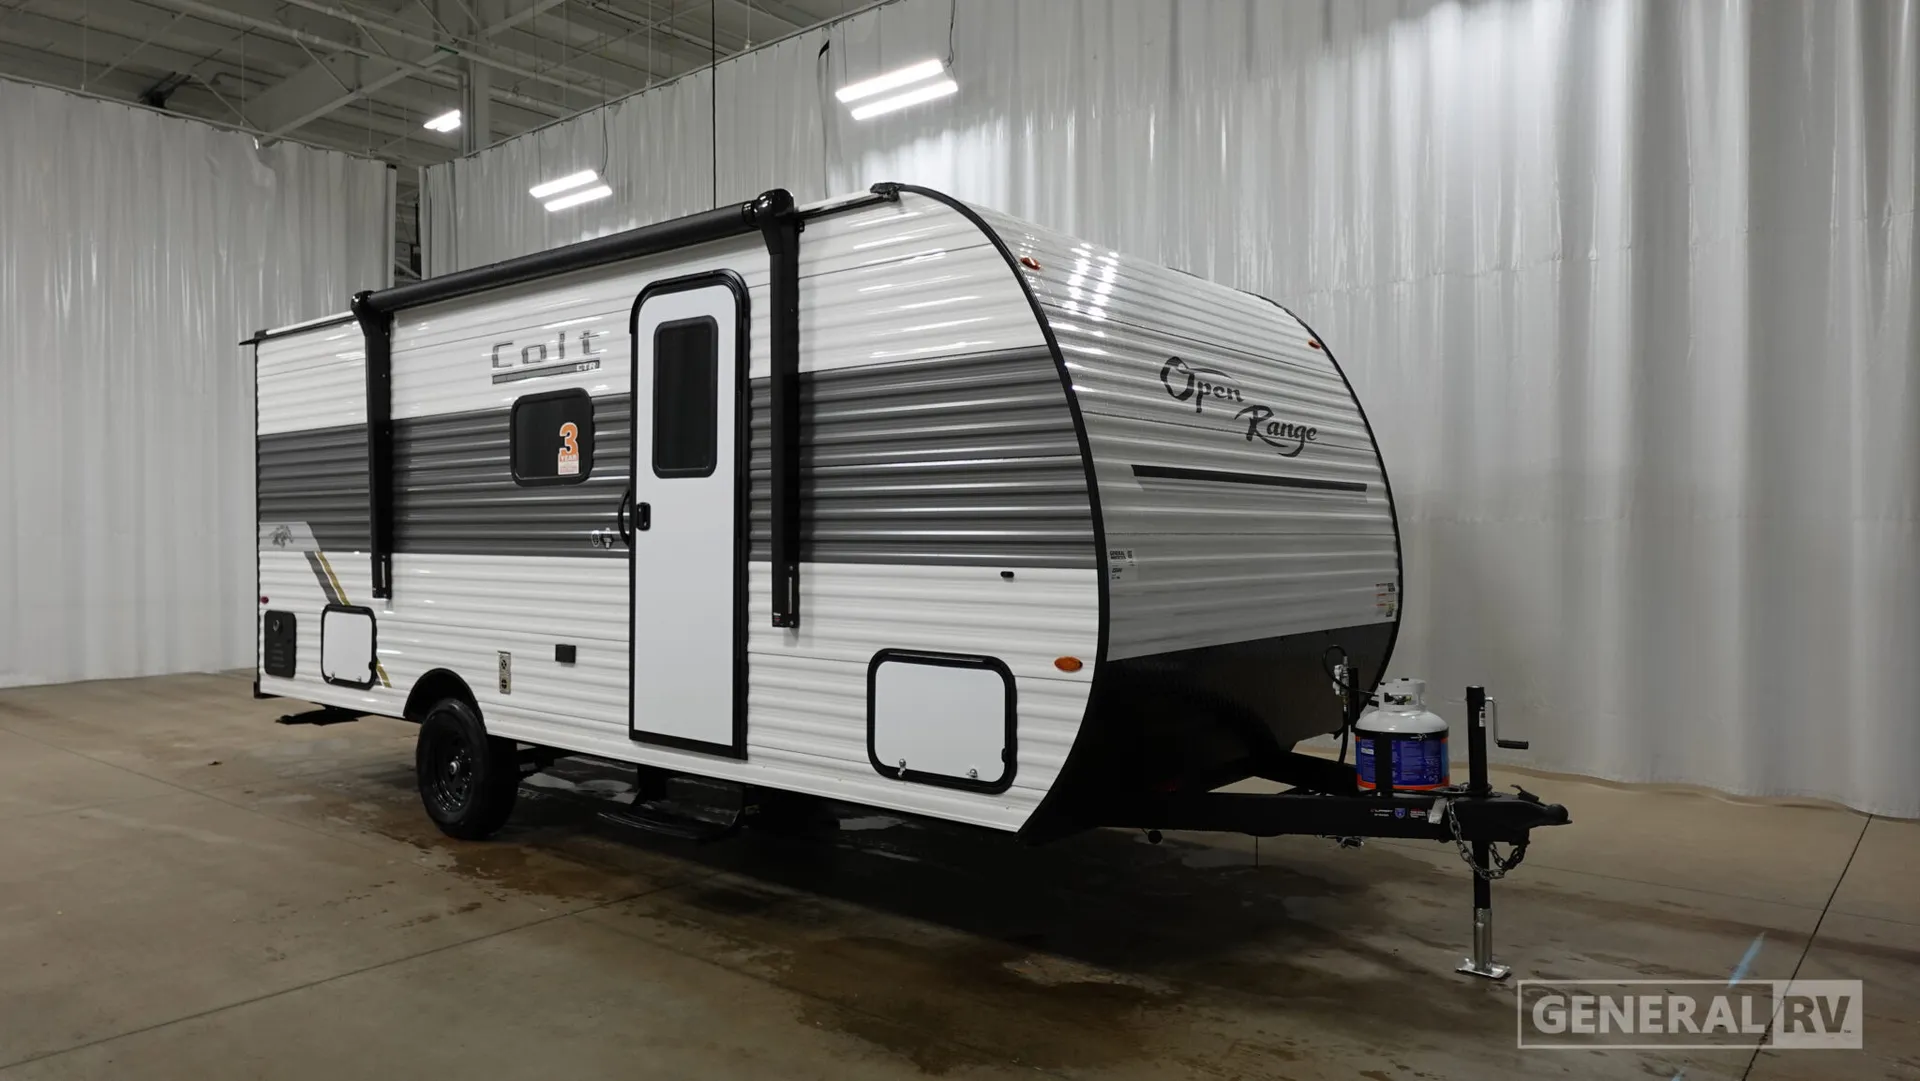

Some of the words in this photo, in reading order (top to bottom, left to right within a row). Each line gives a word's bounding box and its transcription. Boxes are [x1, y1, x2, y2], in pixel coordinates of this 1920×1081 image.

[492, 330, 600, 368] Colt
[576, 362, 596, 371] CTR
[1160, 356, 1244, 413] Open
[559, 422, 578, 456] 3
[1234, 404, 1318, 457] Range
